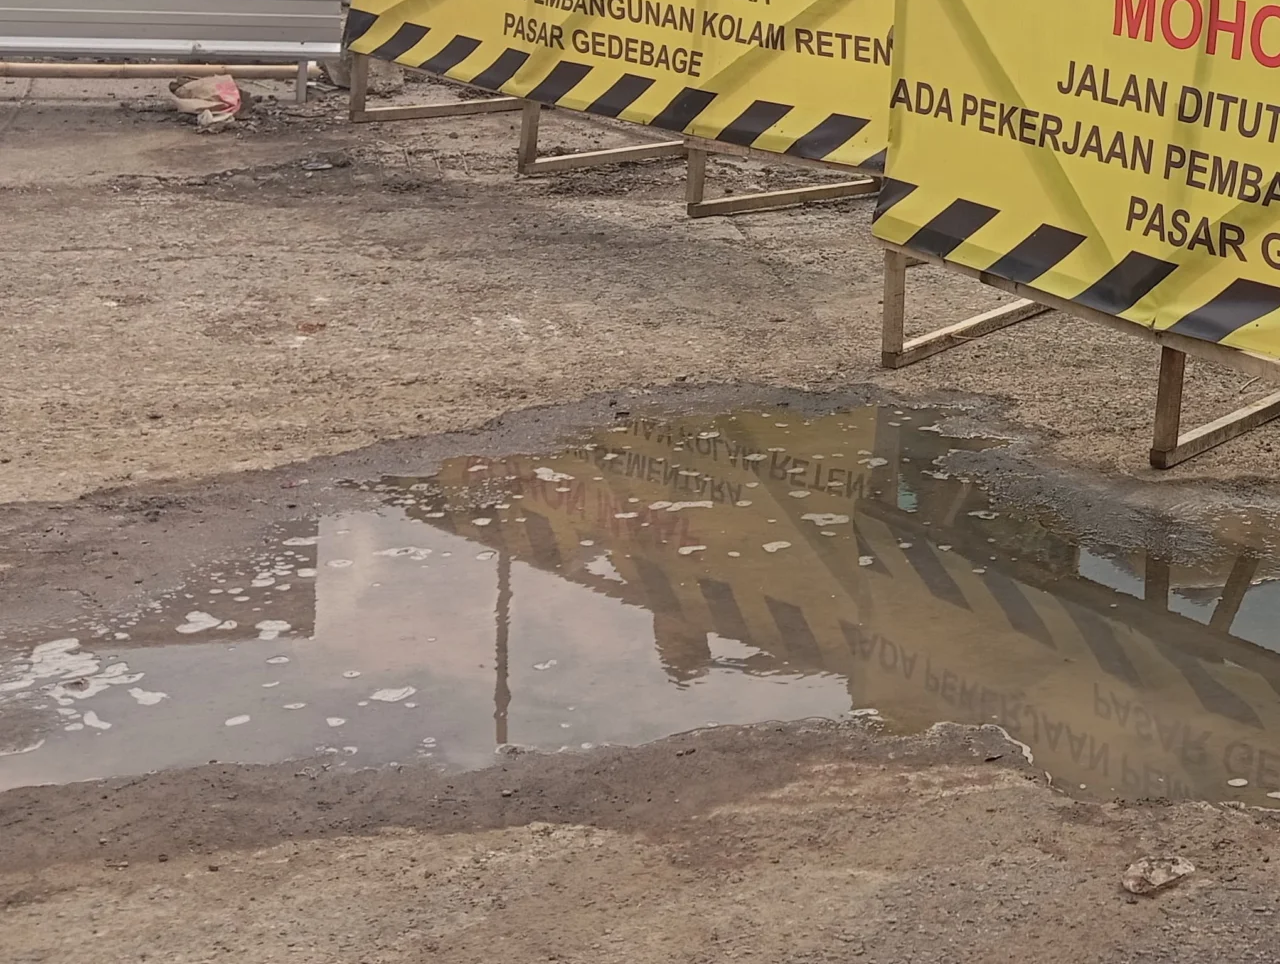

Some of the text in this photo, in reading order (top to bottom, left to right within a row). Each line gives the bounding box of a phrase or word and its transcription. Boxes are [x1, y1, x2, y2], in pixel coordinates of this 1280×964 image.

[502, 12, 705, 78] PASAR GEDEBAGE
[701, 11, 787, 52] KOLAM
[1056, 59, 1168, 117] JALAN
[889, 77, 954, 123] ADA
[960, 93, 1155, 175] PEKERJAAN
[1125, 194, 1248, 263] PASAR
